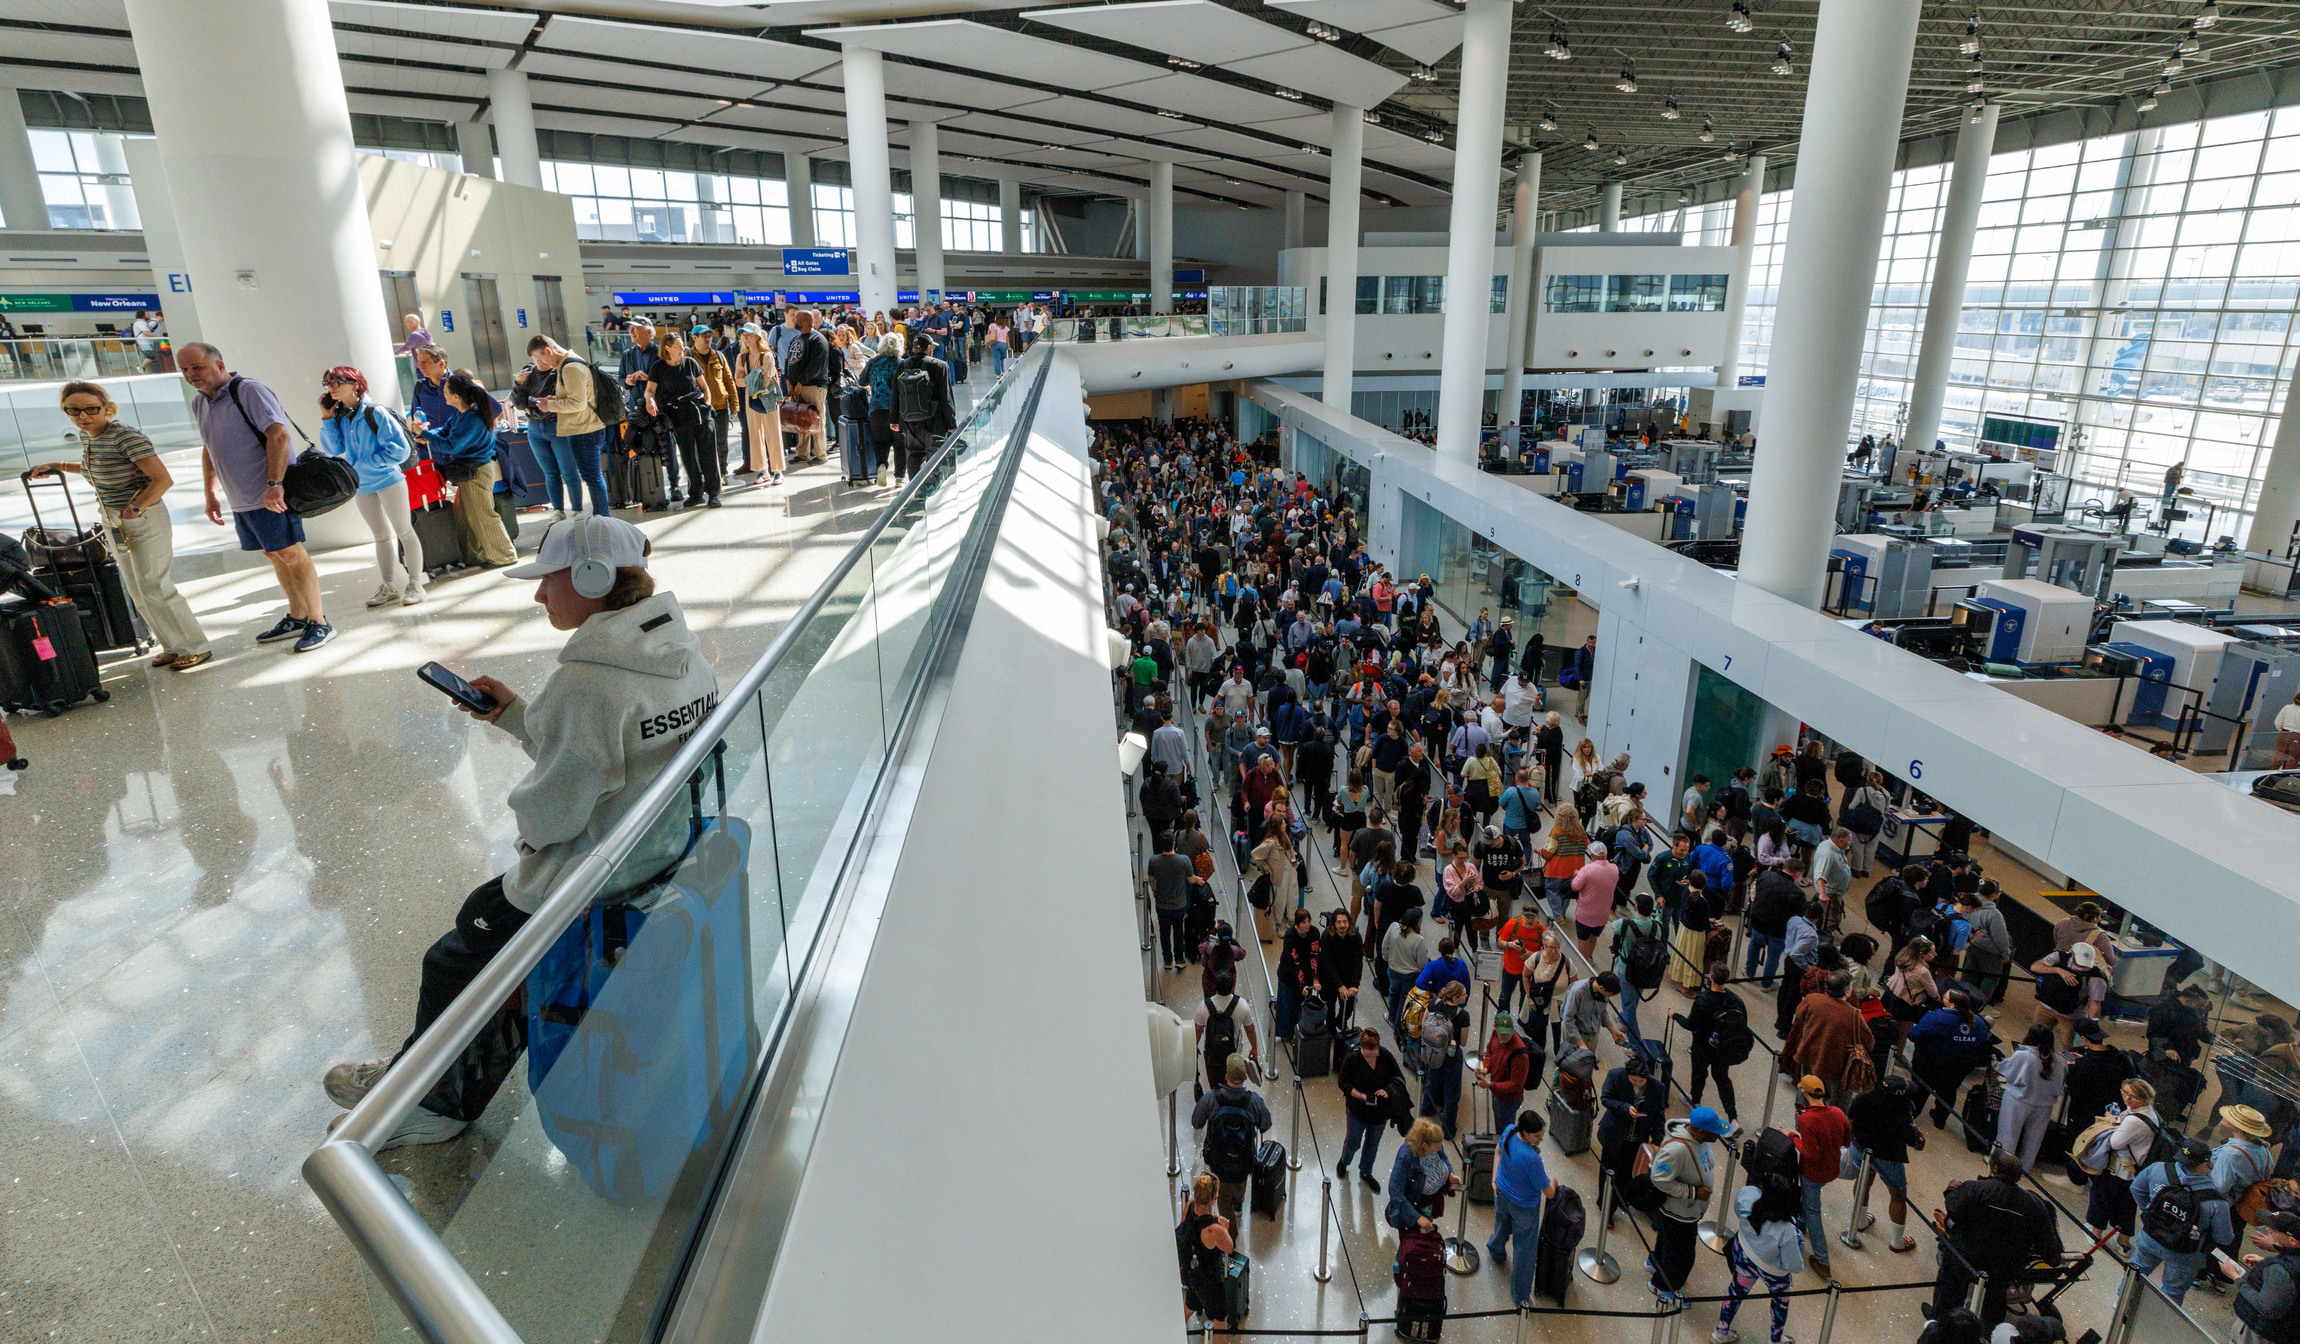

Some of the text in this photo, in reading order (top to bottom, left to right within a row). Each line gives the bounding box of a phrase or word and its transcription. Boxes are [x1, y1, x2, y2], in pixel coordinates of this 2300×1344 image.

[1426, 491, 1431, 502] 10
[1490, 527, 1495, 537] 9
[1575, 573, 1581, 586] 8
[1724, 655, 1732, 671] 7
[1909, 759, 1923, 780] 6
[2163, 1201, 2187, 1219] FOX
